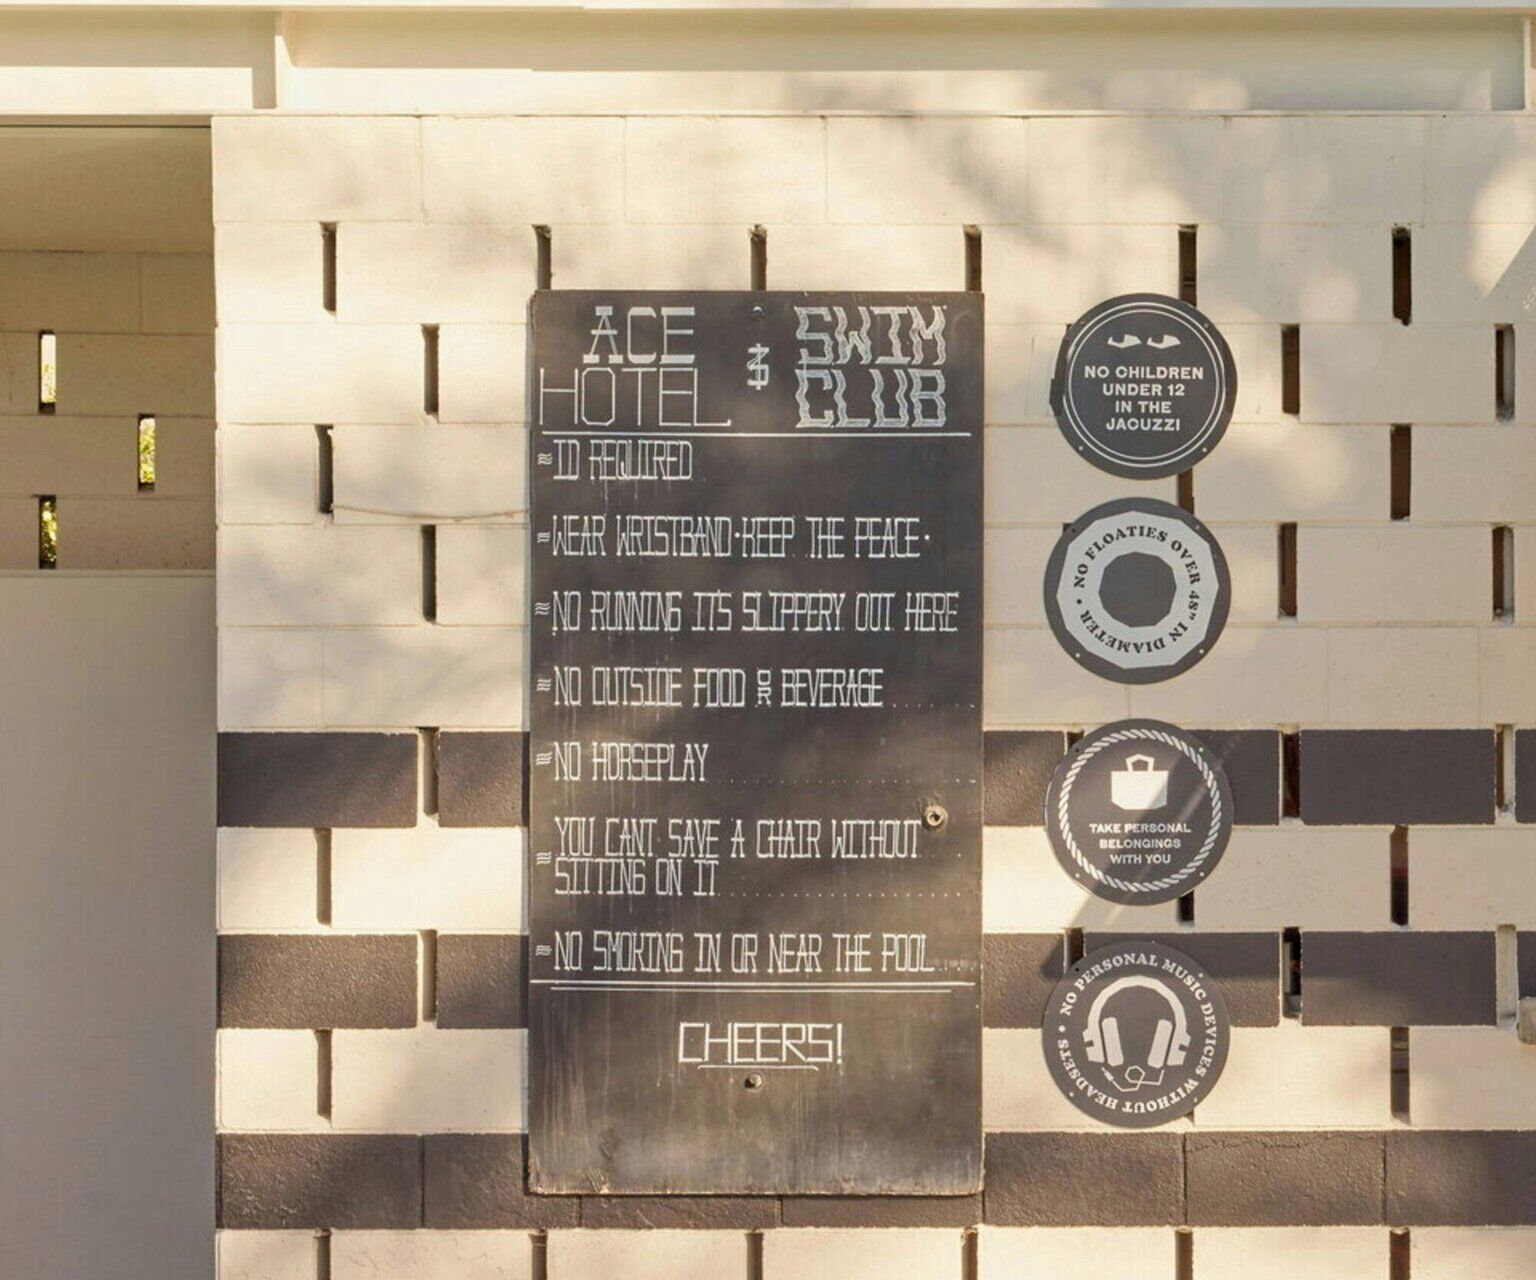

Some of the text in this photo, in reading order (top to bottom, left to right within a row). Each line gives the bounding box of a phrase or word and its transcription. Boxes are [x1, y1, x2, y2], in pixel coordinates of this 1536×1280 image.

[583, 306, 695, 364] ACE
[794, 305, 947, 365] SWIM
[1084, 365, 1203, 380] NO CHILDREN
[1103, 384, 1185, 396] UNDER 12
[540, 367, 732, 427] HOTEL
[794, 369, 946, 428] CLUB
[1115, 401, 1172, 414] IN THE
[1106, 418, 1180, 432] JACUZZI
[553, 440, 692, 481] ID REQUIRED
[552, 515, 921, 559] WEAR WRISTBAND KEEP THE PEACE
[1085, 525, 1168, 560] FLOATIES
[1073, 564, 1088, 588] NO
[1170, 540, 1201, 585] OVER
[551, 591, 582, 632] NO
[590, 591, 682, 632] RUNNING
[741, 592, 845, 632] SLIPPERY
[855, 593, 895, 632] OUT
[904, 592, 960, 632] HERE
[1080, 610, 1165, 654] DIAMETER
[1168, 621, 1188, 642] IN
[553, 666, 884, 708] NO OUTSIDE FOOD OR BEVERAGE
[553, 741, 709, 782] NO HORSEPLAY
[554, 816, 595, 858] YOU
[668, 819, 720, 858] SAVE
[730, 819, 745, 858] A
[756, 819, 822, 858] CHAIR
[831, 819, 921, 858] WITHOUT
[1089, 823, 1191, 833] TAKE PERSONAL
[1099, 839, 1181, 849] BELONGINGS
[553, 858, 719, 896] SITTING ON IT
[1110, 854, 1171, 864] WITH YOU
[553, 931, 935, 973] NO SMOKING IN OR NEAR THE POOL
[678, 1022, 843, 1064] CHEERS!
[1057, 953, 1217, 1114] NO PERSONAL MUSIC DEVICES WITHOUT HEADSETS
